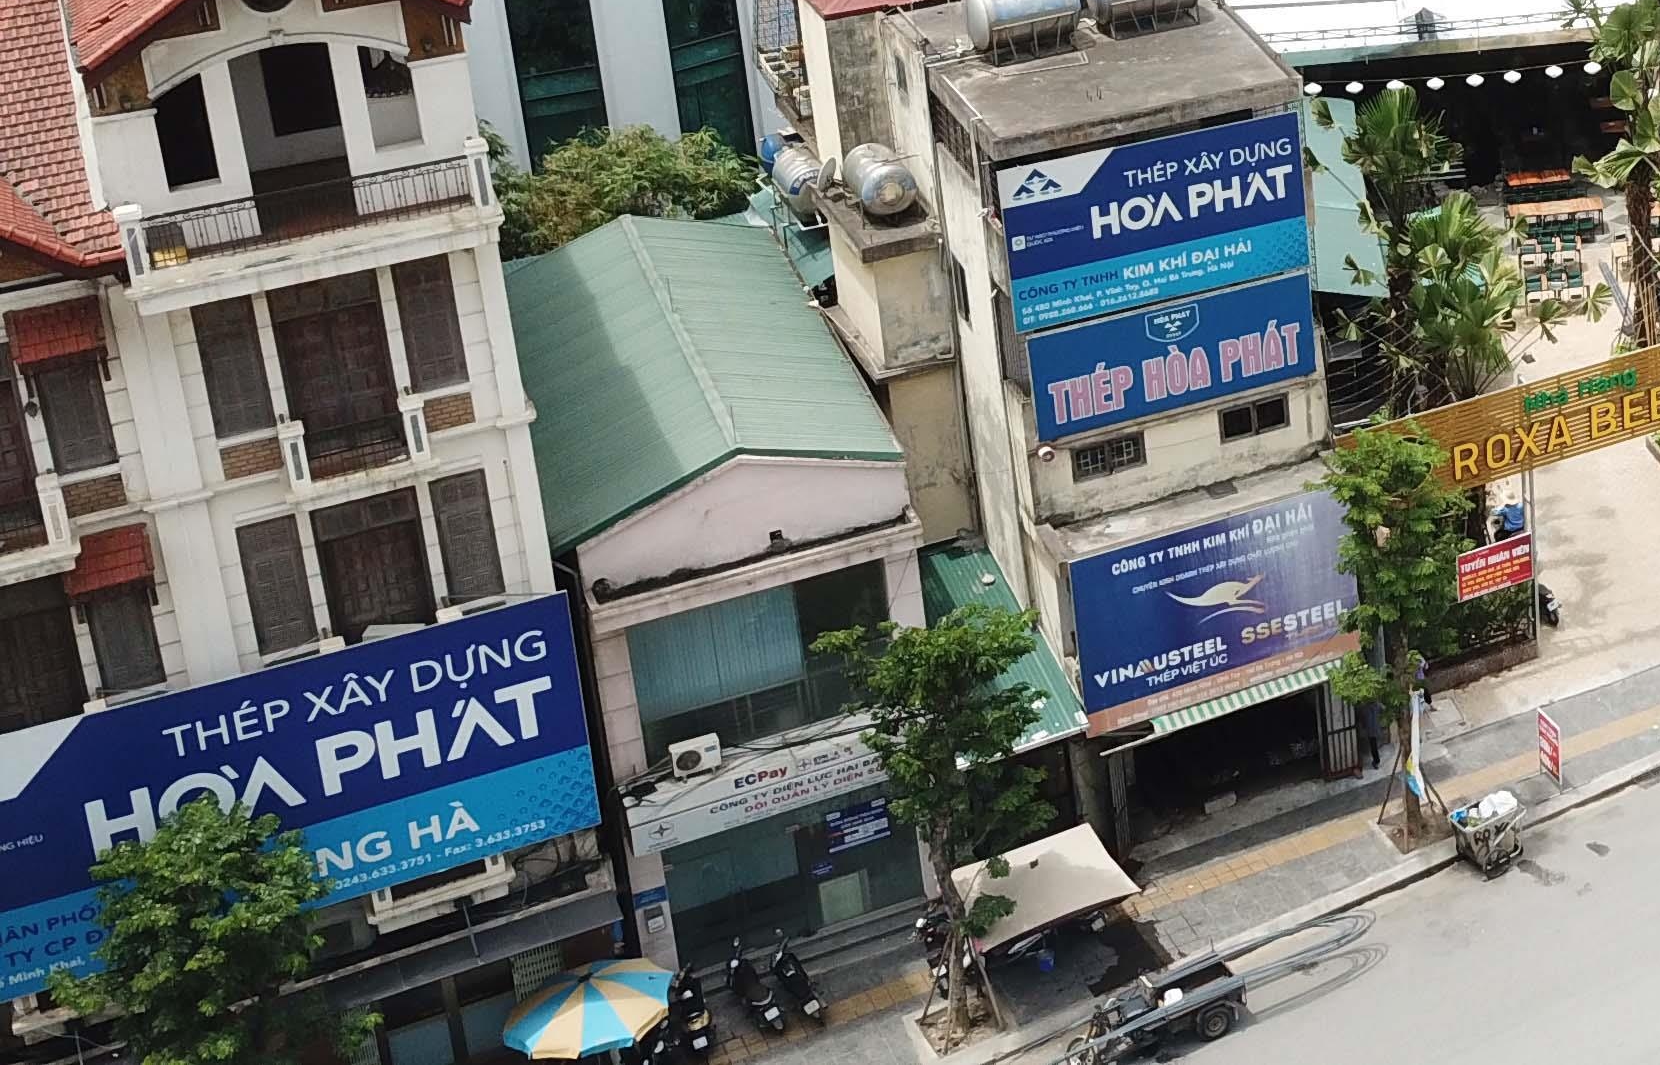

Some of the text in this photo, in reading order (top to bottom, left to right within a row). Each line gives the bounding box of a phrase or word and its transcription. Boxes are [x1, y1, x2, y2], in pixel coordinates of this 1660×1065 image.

[1124, 138, 1292, 188] THÉP XÂY DỰNG
[1090, 165, 1293, 240] HÒA PHÁT
[1018, 237, 1251, 300] CÔNG TY TNHH KIM KHÍ ĐẠI HẢI
[1048, 319, 1301, 424] THÉP HÒA PHÁT
[1453, 414, 1574, 481] ROXA
[1111, 554, 1146, 576] CÔNG
[1149, 549, 1164, 565] TY
[1168, 541, 1200, 560] TNHH
[1203, 533, 1226, 550] KIM
[1229, 523, 1250, 543] KHÍ
[1252, 511, 1281, 534] ĐẠI
[1285, 502, 1313, 525] HẢI
[1241, 599, 1348, 645] SSESTEEL
[1094, 637, 1227, 688] VINAUSTEEL
[1145, 667, 1181, 687] THÉP
[1180, 658, 1207, 677] VIỆT
[1209, 652, 1228, 668] ÚC
[162, 629, 548, 758] THÉP XÂY DỰNG
[315, 675, 553, 797] PHÁT
[710, 797, 748, 814] CÔNG
[754, 790, 769, 802] TY
[837, 762, 859, 775] HAI
[734, 766, 788, 789] ECPay
[408, 801, 481, 850] HÀ
[444, 841, 473, 858] Fax:
[474, 819, 547, 848] 3.633.3753
[6, 947, 35, 967] TY
[44, 935, 76, 958] CP
[9, 967, 45, 986] Minh
